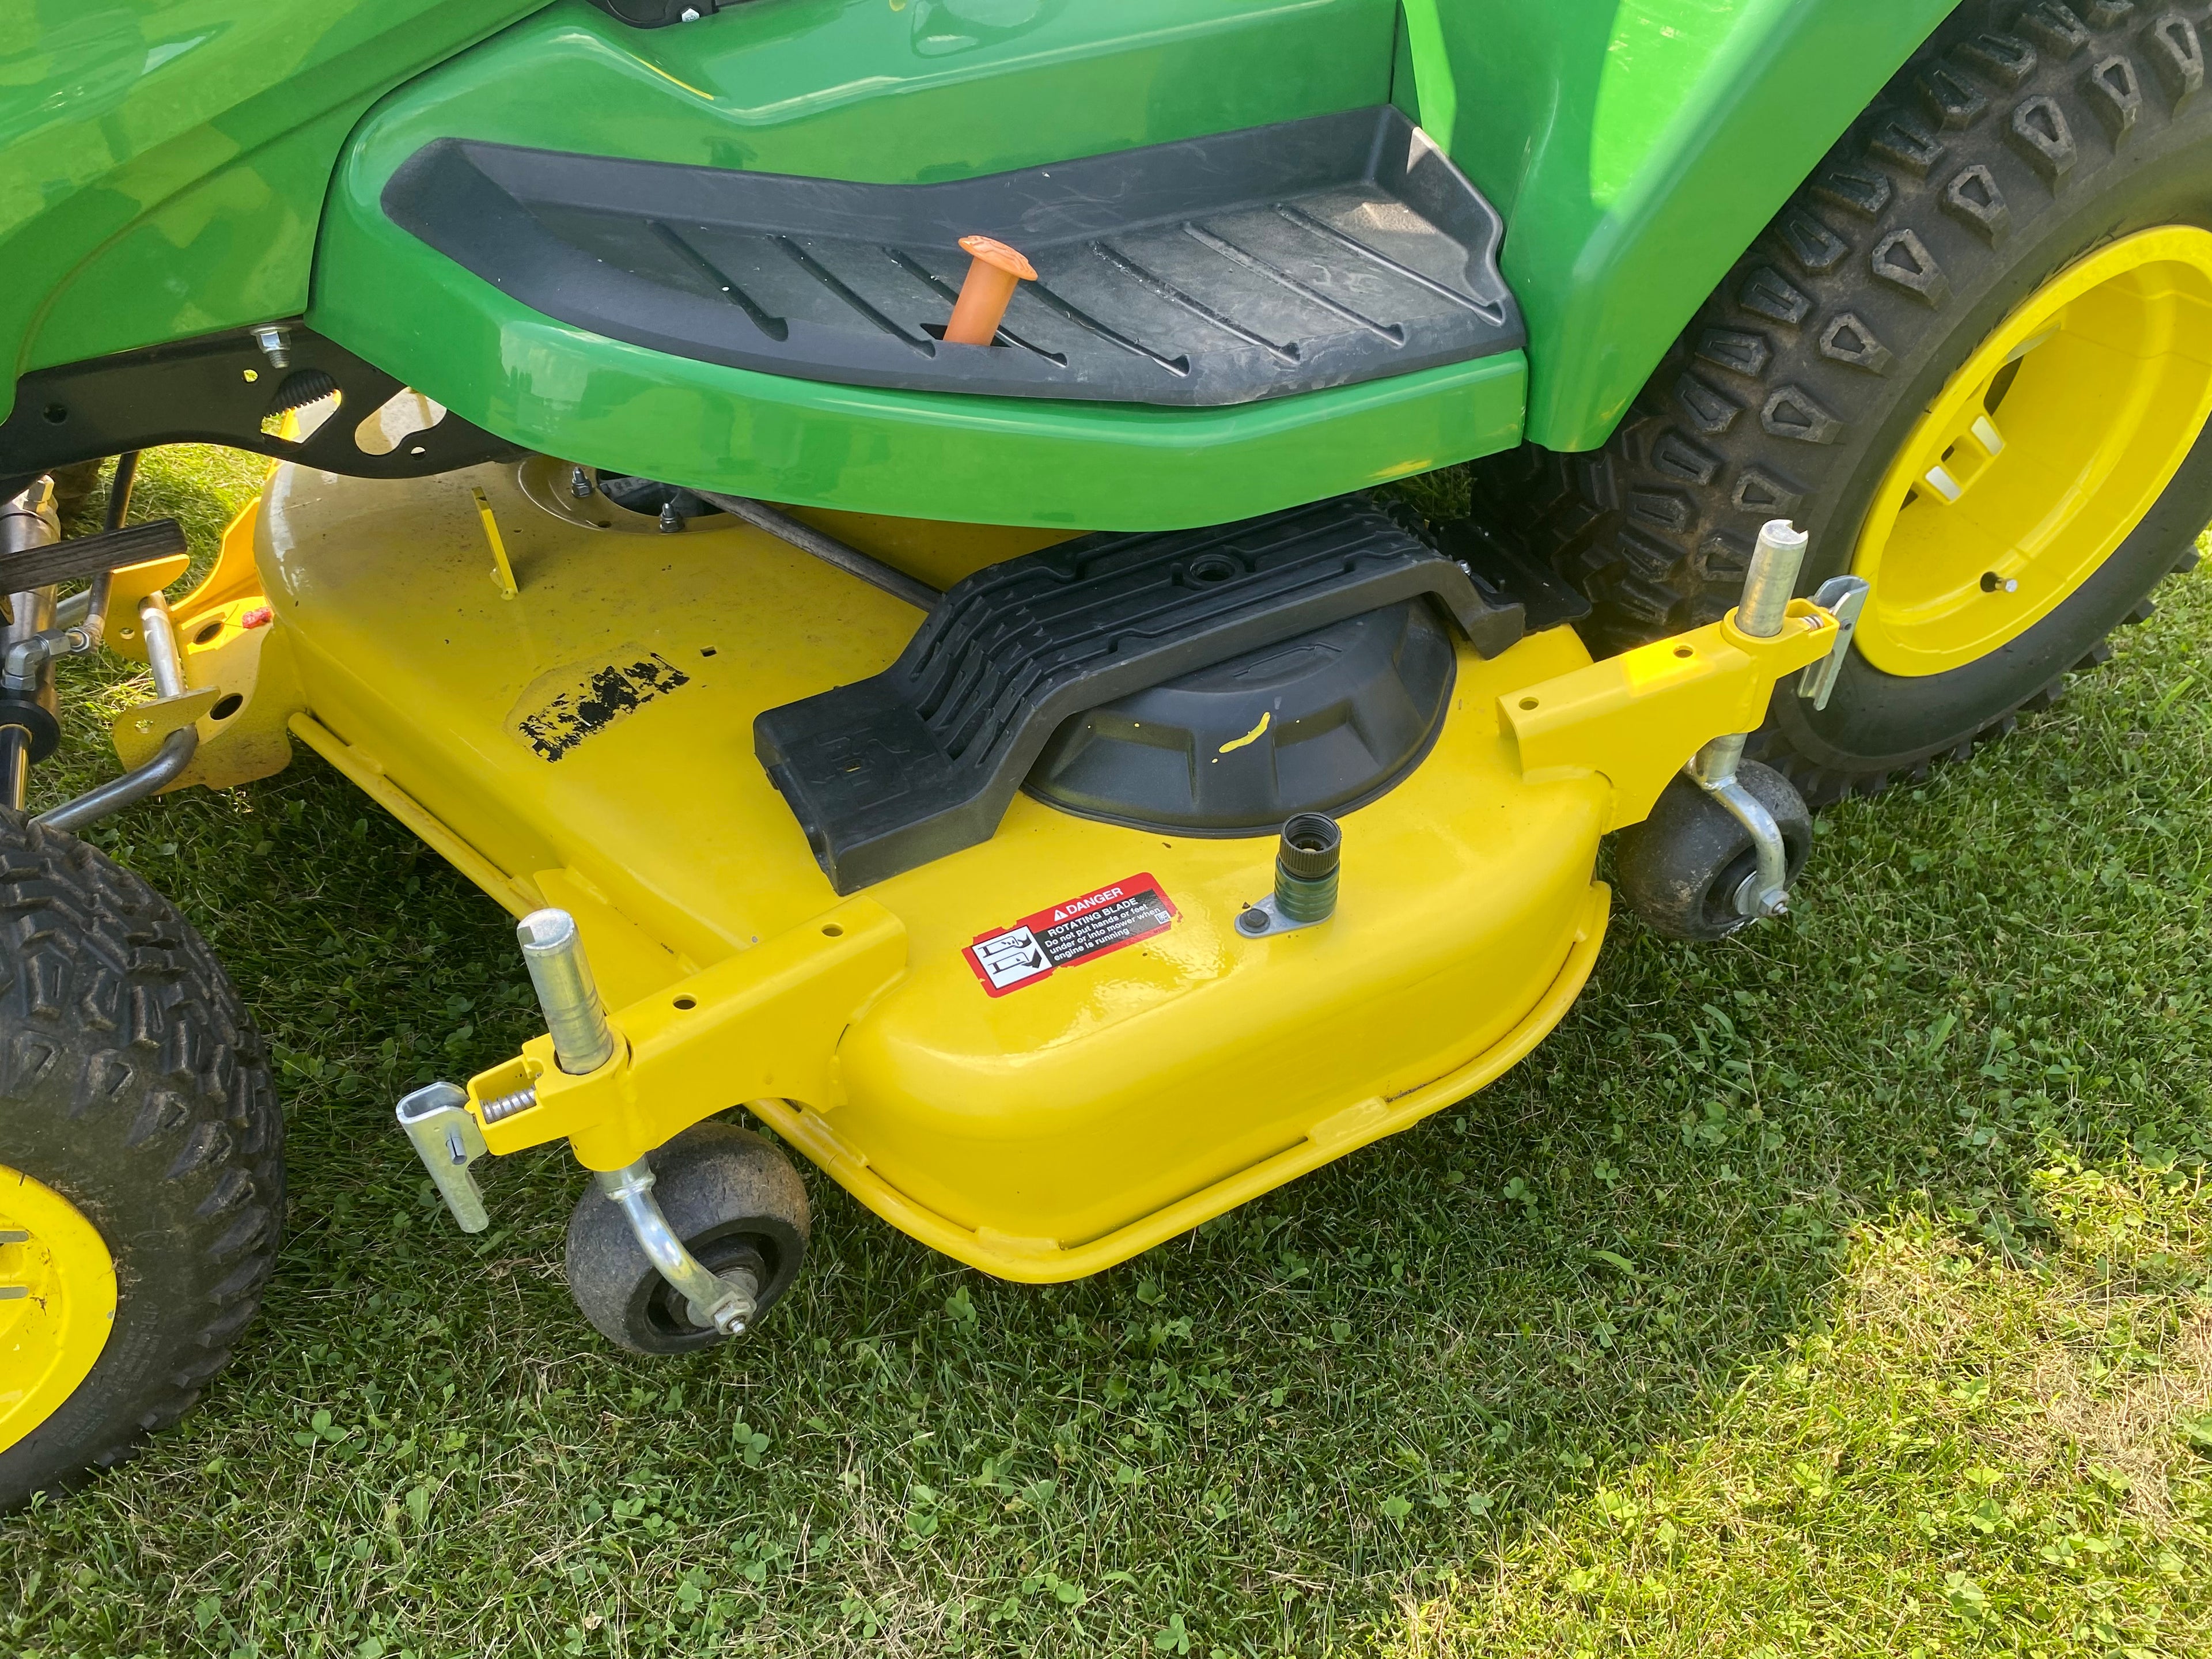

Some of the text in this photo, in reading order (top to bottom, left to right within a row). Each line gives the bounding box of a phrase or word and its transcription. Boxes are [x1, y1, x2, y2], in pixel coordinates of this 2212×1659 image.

[1047, 897, 1138, 937] ROTATING BLADE
[1066, 887, 1124, 915] DANGER
[1044, 940, 1058, 948] Do
[1059, 931, 1075, 942] not
[1075, 926, 1092, 937] put
[1091, 915, 1119, 930] hands
[1130, 903, 1149, 914] feet
[1050, 907, 1161, 954] under or into mower when
[1054, 945, 1084, 961] engine
[1094, 927, 1130, 945] running
